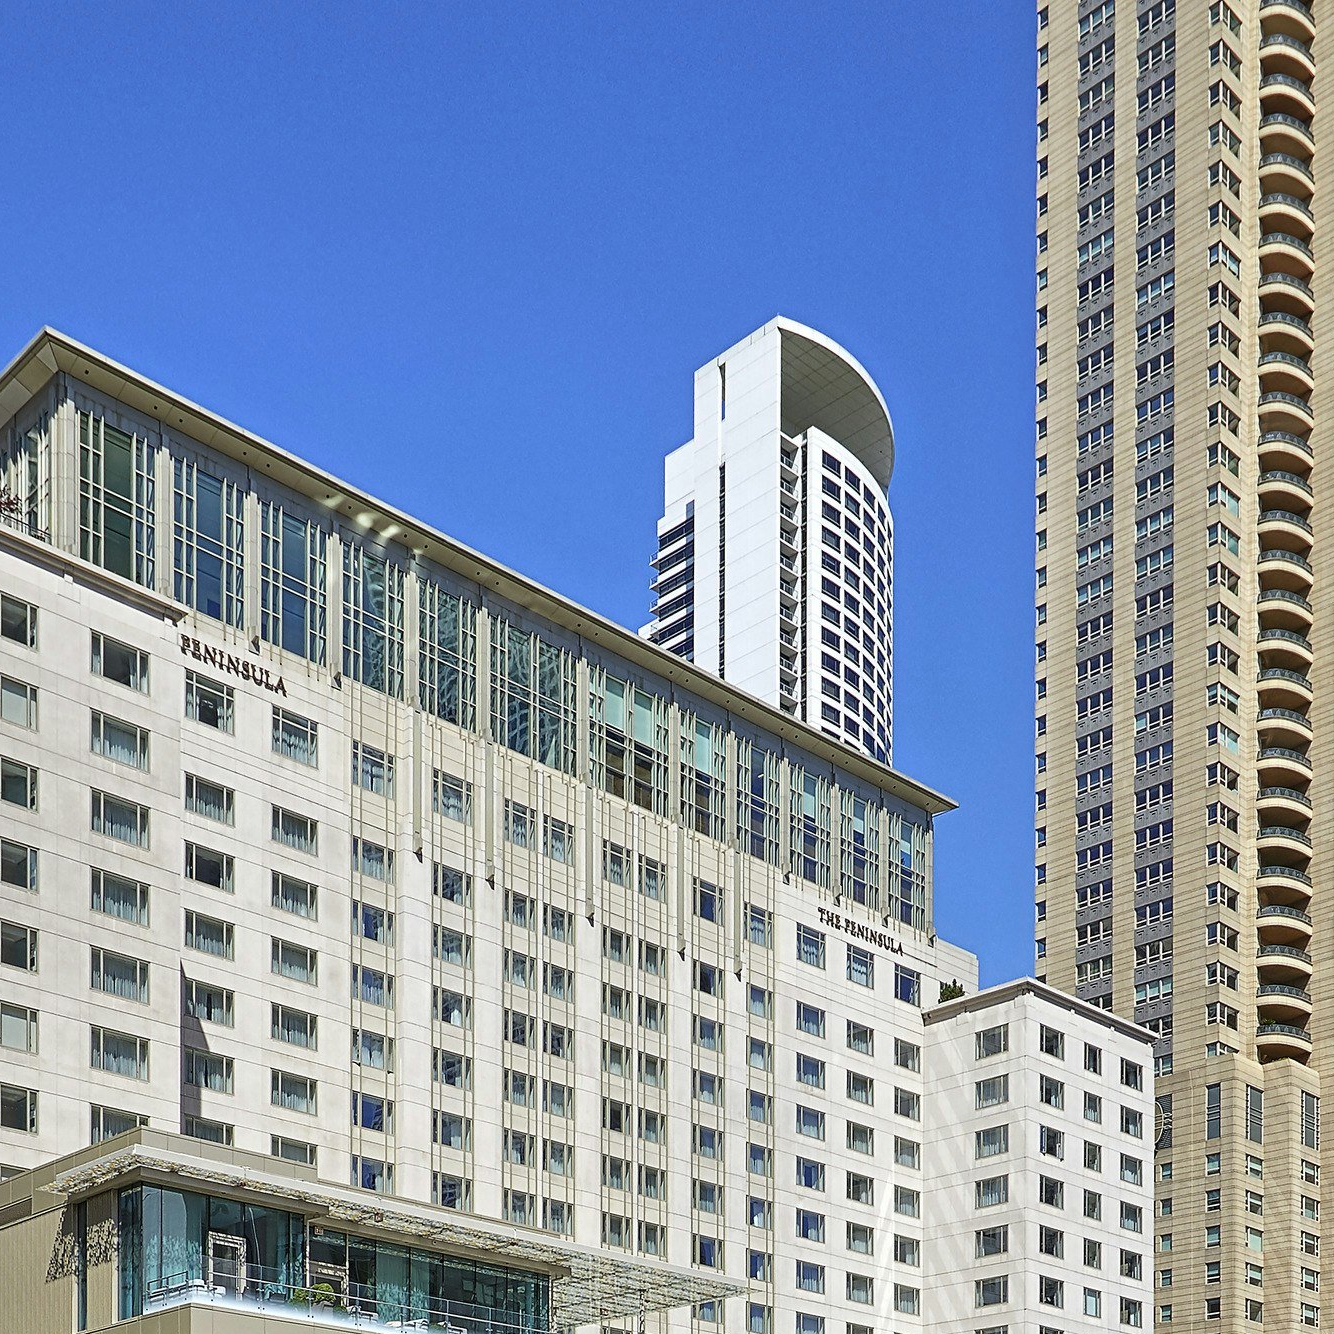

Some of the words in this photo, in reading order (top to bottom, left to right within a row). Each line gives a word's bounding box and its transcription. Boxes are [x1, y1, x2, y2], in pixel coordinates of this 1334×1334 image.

[181, 634, 287, 698] PENINSULA
[818, 906, 841, 930] THE
[844, 918, 903, 957] PENINSULA
